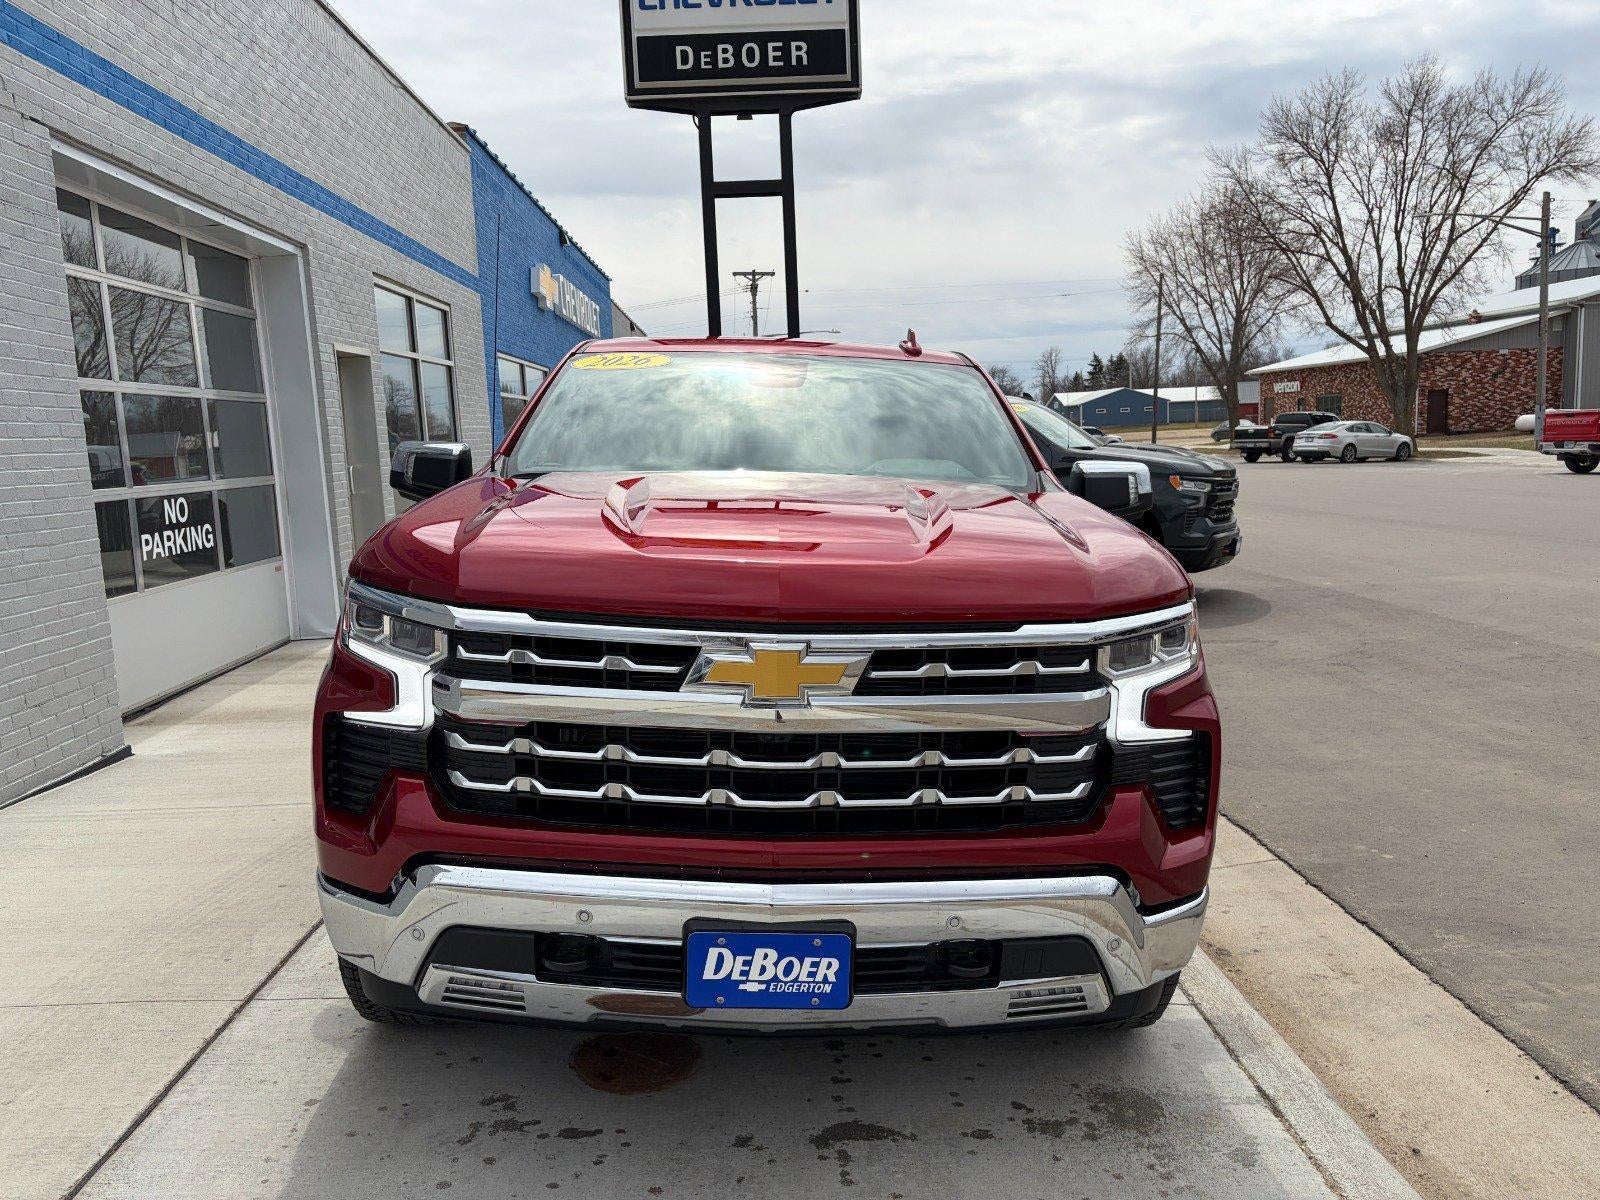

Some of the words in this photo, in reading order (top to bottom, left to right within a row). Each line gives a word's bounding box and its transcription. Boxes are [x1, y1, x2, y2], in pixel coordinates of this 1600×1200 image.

[585, 355, 651, 367] 2026
[1273, 379, 1301, 394] verizon
[163, 496, 189, 525] NO
[140, 523, 215, 561] PARKING
[769, 982, 833, 994] EDGERTON
